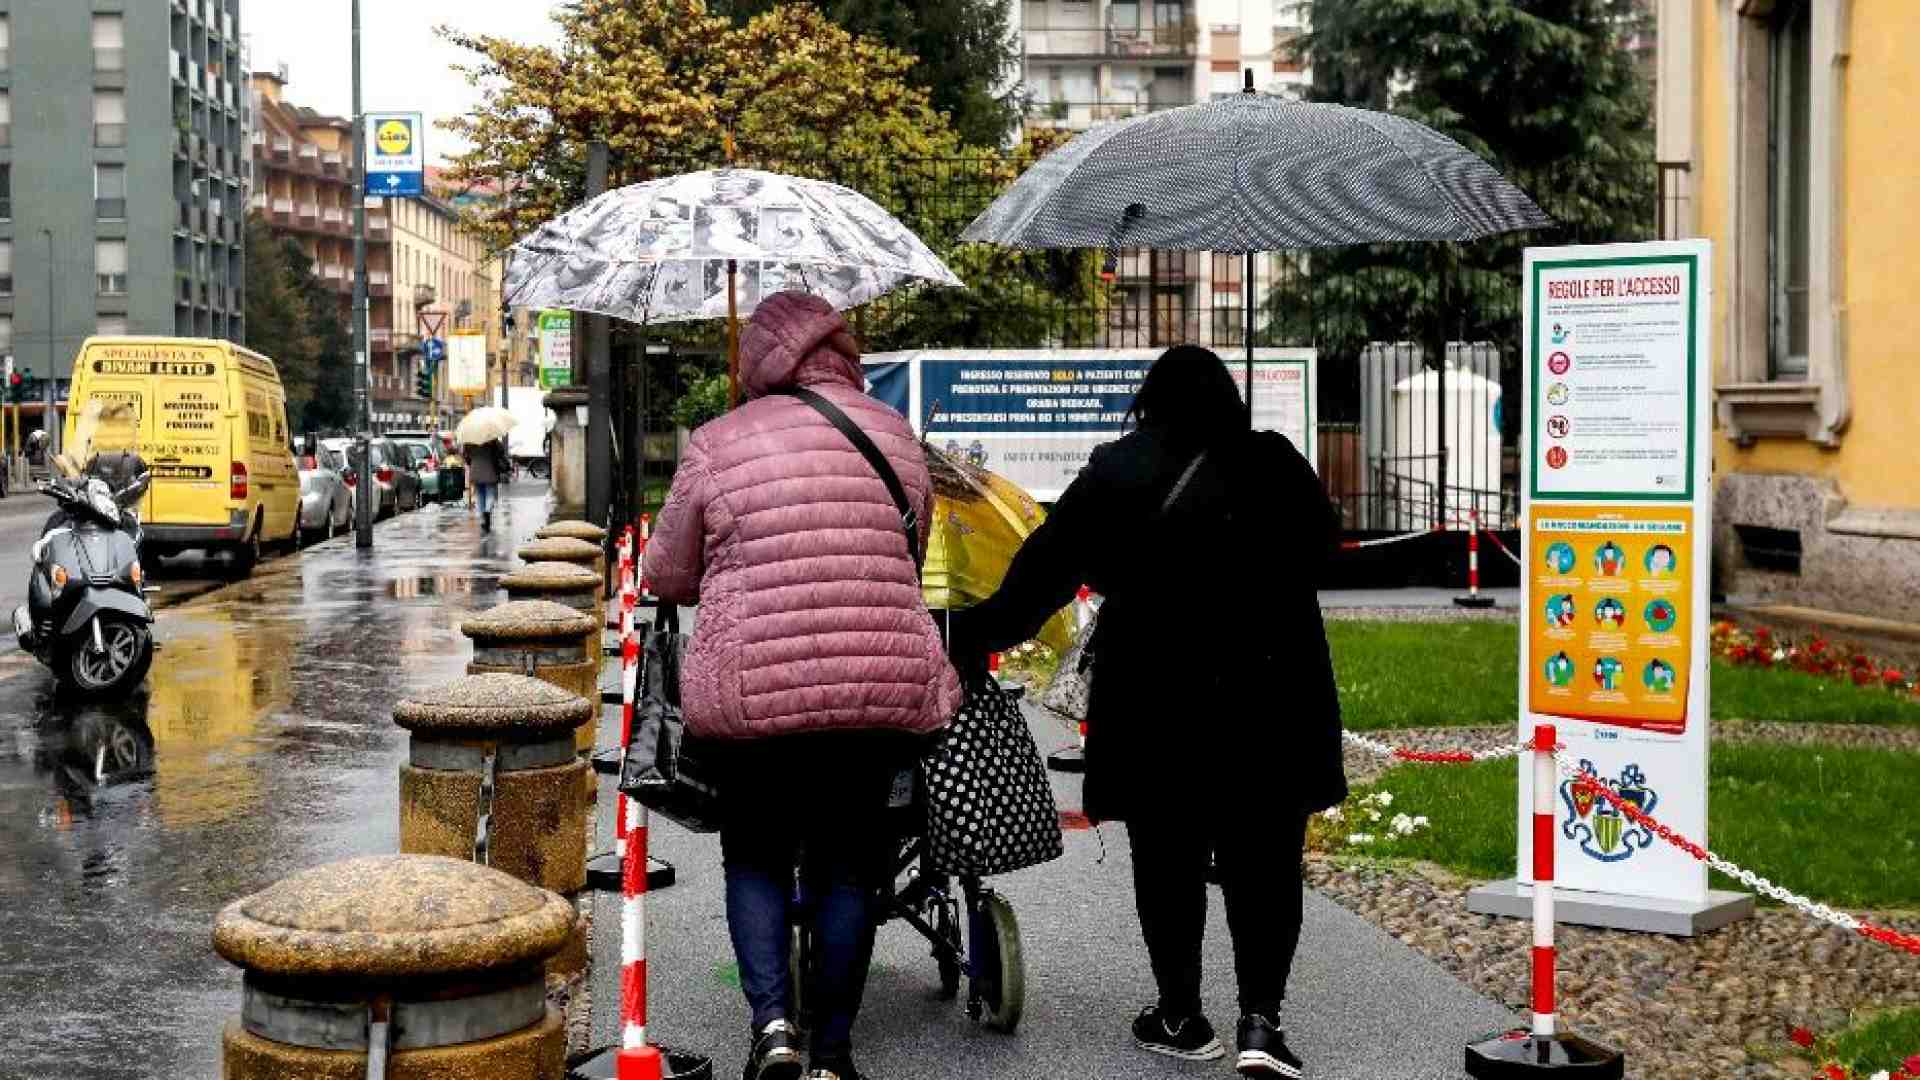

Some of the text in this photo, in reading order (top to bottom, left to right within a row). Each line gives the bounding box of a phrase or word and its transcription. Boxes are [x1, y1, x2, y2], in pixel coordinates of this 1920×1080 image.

[1548, 275, 1681, 299] REGOLE PER L'ACCESSO
[104, 350, 187, 360] SPECIALISTA
[102, 360, 207, 375] DIVANI LETTO
[960, 369, 1003, 380] INGRESSO
[1004, 369, 1050, 380] RISERVATO
[1051, 369, 1074, 380] SOLO
[1085, 369, 1122, 380] PAZIENTI
[1124, 369, 1143, 380] CON
[952, 384, 999, 394] PRENOTATA
[1010, 384, 1071, 394] PRENOTAZIONI
[1073, 384, 1090, 394] PER
[1092, 384, 1131, 394] URGENZE
[163, 402, 219, 411] MATERASSI
[1026, 398, 1104, 409] ORARIA DEDICATA.
[951, 412, 1007, 422] PRESENTARSI
[1008, 412, 1036, 422] PRIMA
[1039, 412, 1052, 422] DEI
[1068, 412, 1100, 422] MINUTI
[1003, 452, 1028, 462] INFO
